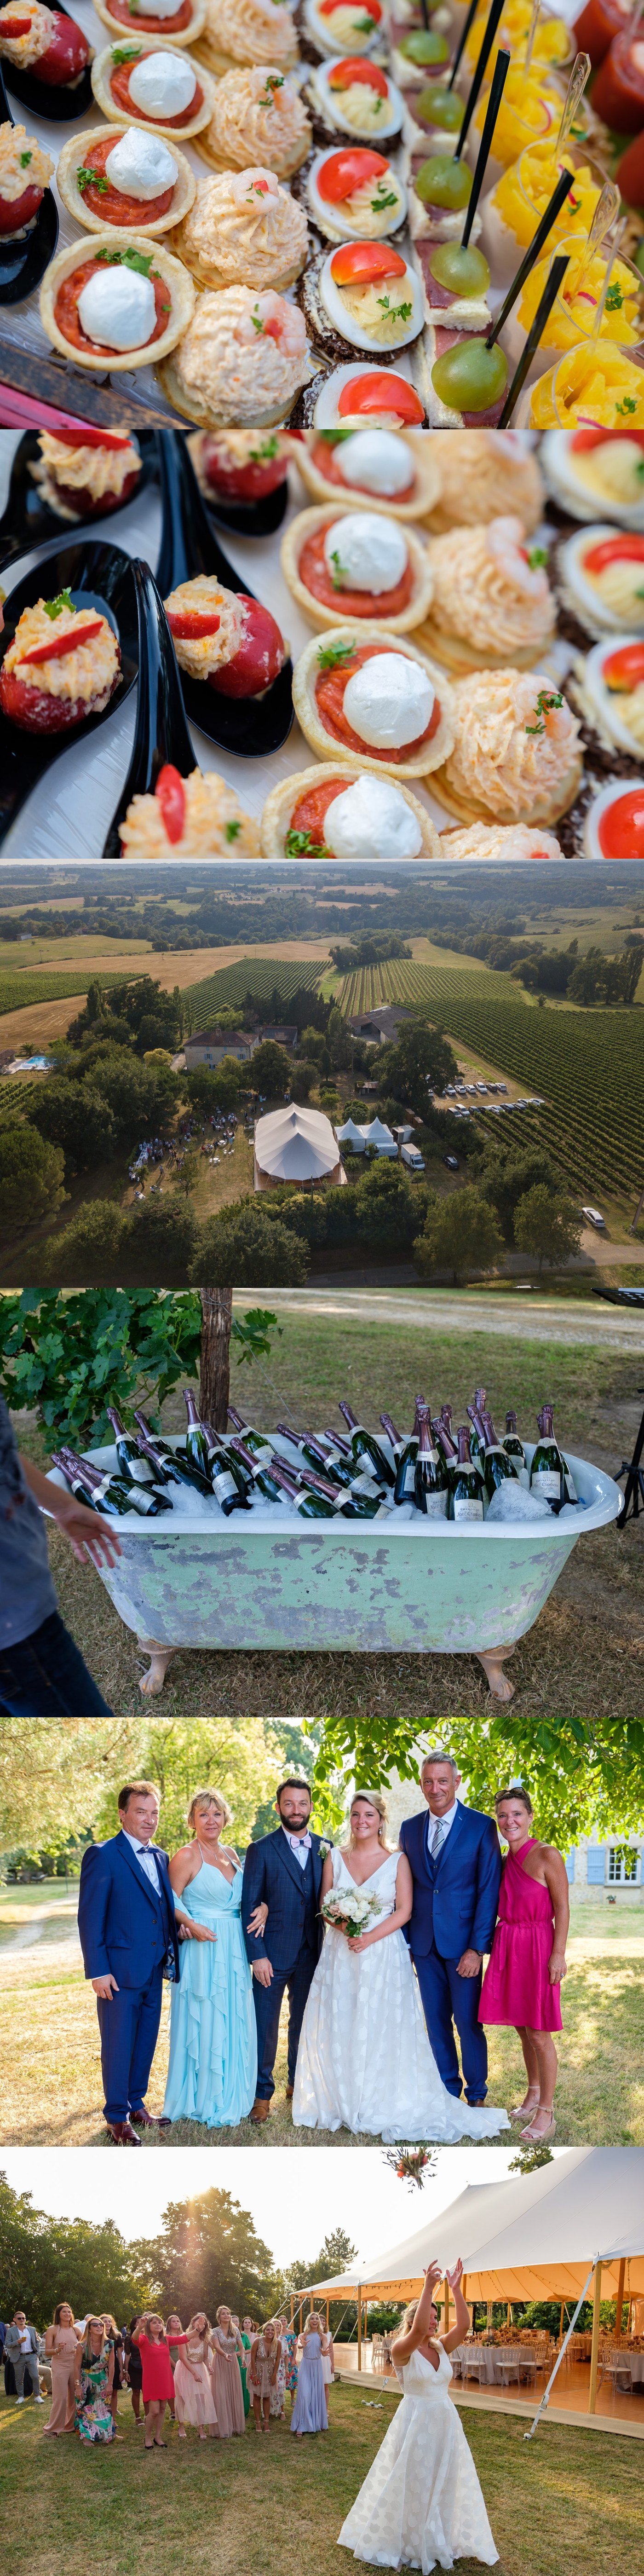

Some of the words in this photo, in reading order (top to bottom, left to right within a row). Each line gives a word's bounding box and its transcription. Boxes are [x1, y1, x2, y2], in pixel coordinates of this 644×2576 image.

[444, 1435, 454, 1452] CHAMPAGNE
[80, 1473, 93, 1487] CHAMPAGNE
[218, 1481, 233, 1490] CLOSSON
[319, 1479, 336, 1491] CHAMPAGNE
